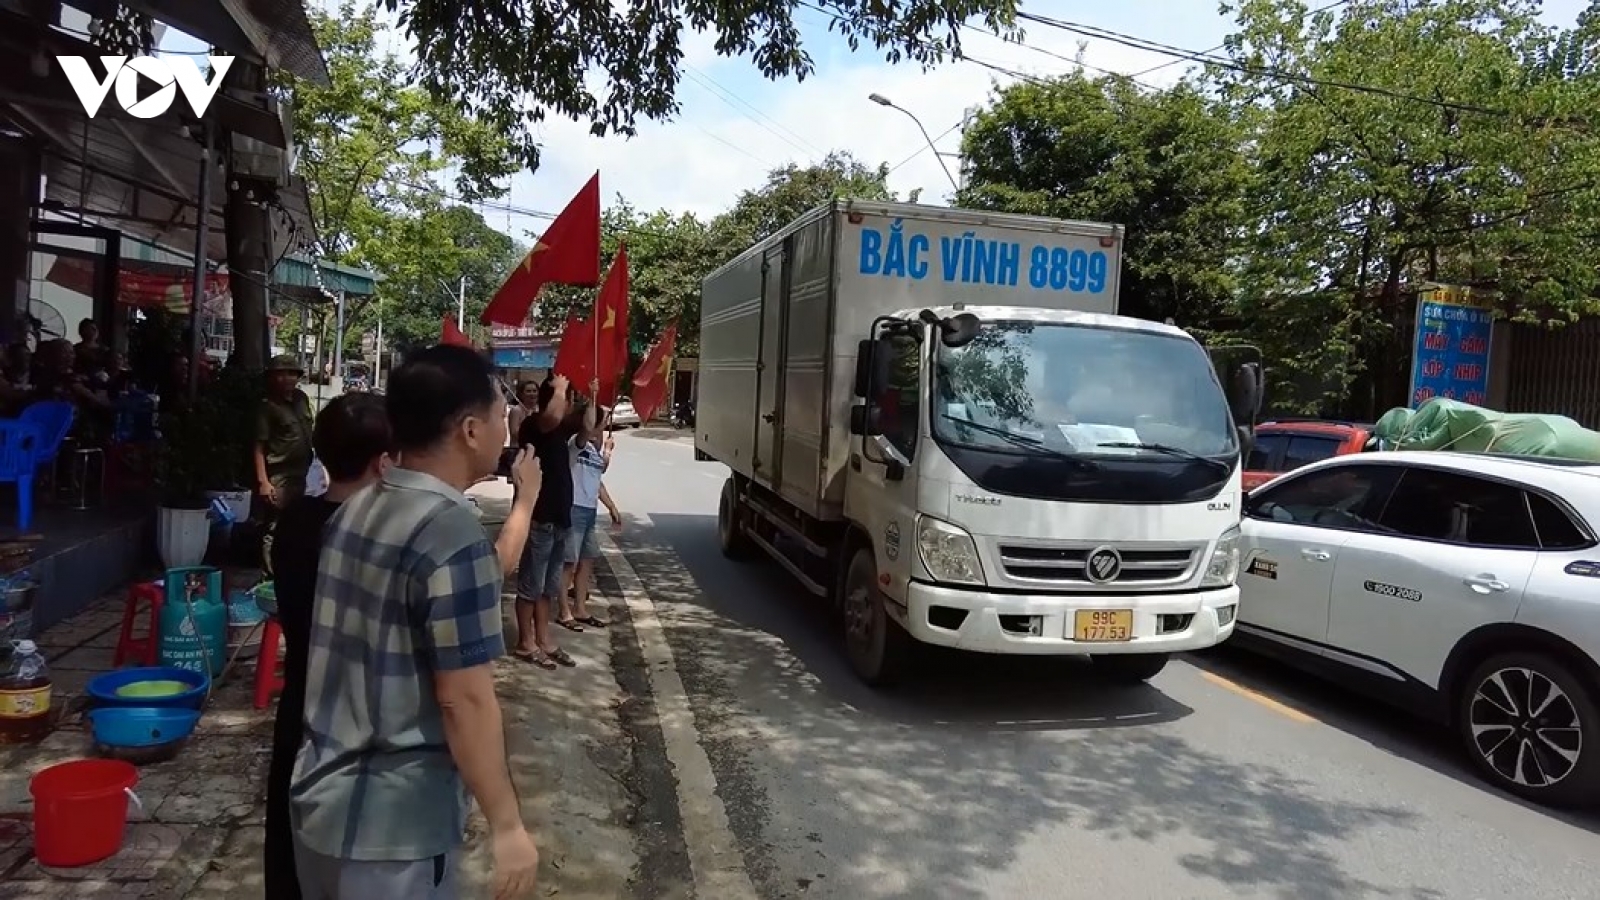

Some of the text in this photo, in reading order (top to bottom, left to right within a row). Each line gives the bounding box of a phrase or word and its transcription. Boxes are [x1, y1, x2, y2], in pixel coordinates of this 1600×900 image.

[859, 217, 1108, 293] BẮC VĨNH 8899
[1092, 611, 1117, 625] 99C
[1083, 626, 1126, 639] 177.53
